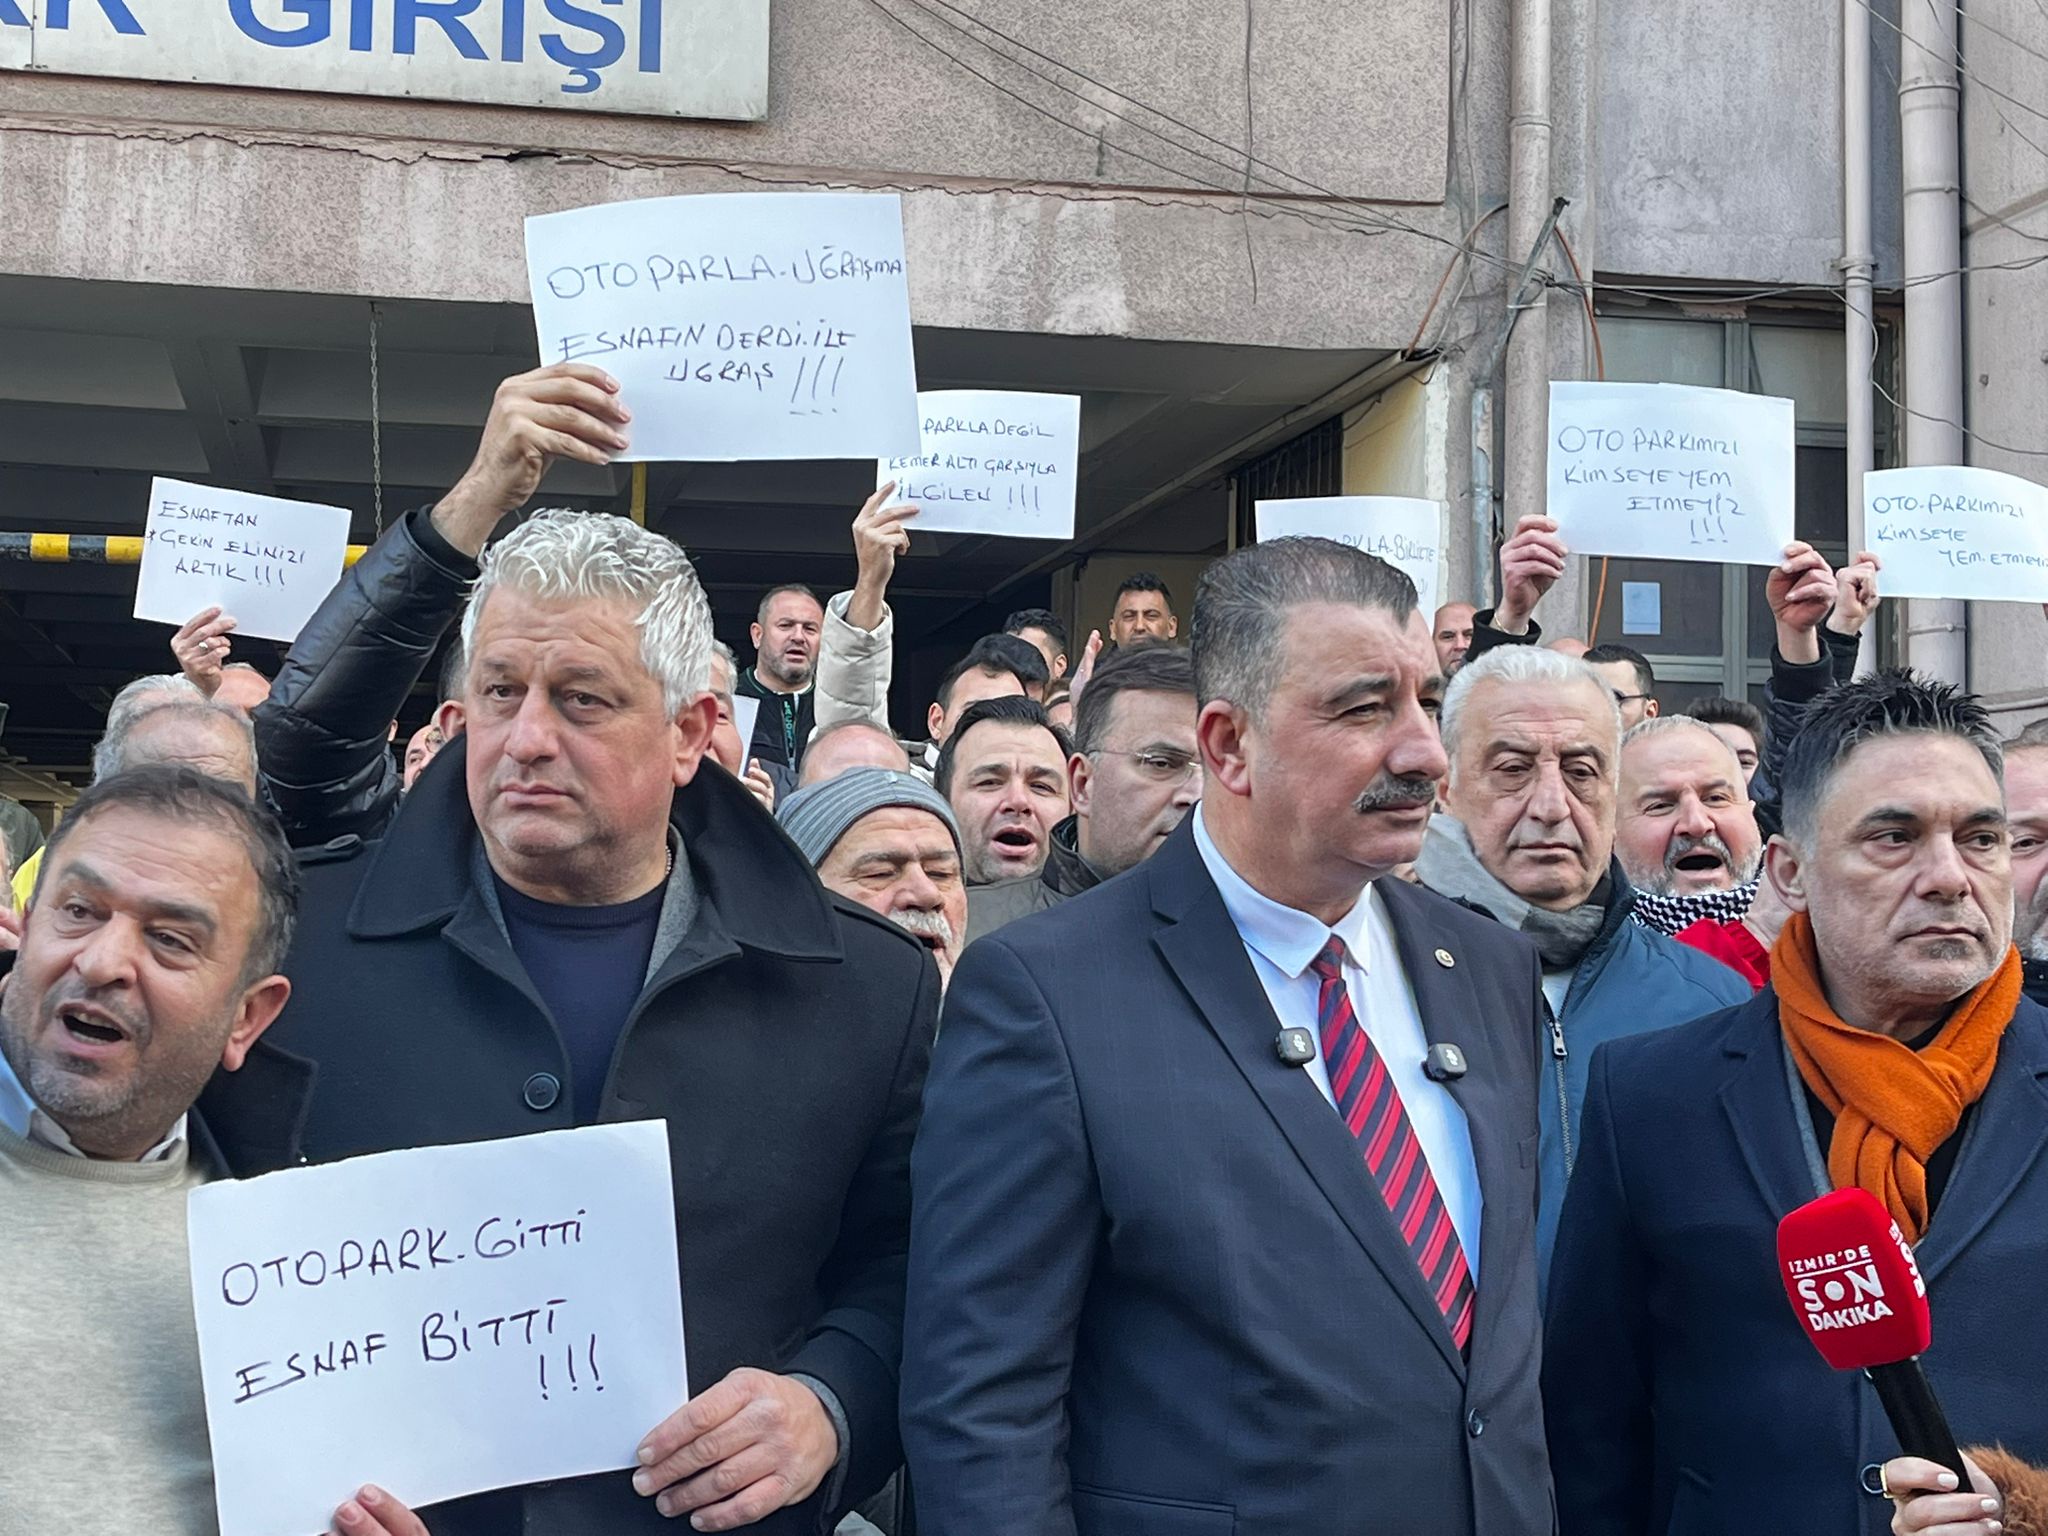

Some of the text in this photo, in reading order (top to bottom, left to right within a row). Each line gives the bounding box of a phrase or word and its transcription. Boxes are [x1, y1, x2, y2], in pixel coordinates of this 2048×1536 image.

[558, 323, 706, 362] ESNAFIN
[1678, 469, 1732, 490] YEM
[157, 500, 259, 527] ESNAFTAN
[175, 557, 247, 582] ARTIK
[1797, 1264, 1885, 1312] SON
[234, 1333, 388, 1404] ESNAF
[539, 1332, 605, 1401] !!!
